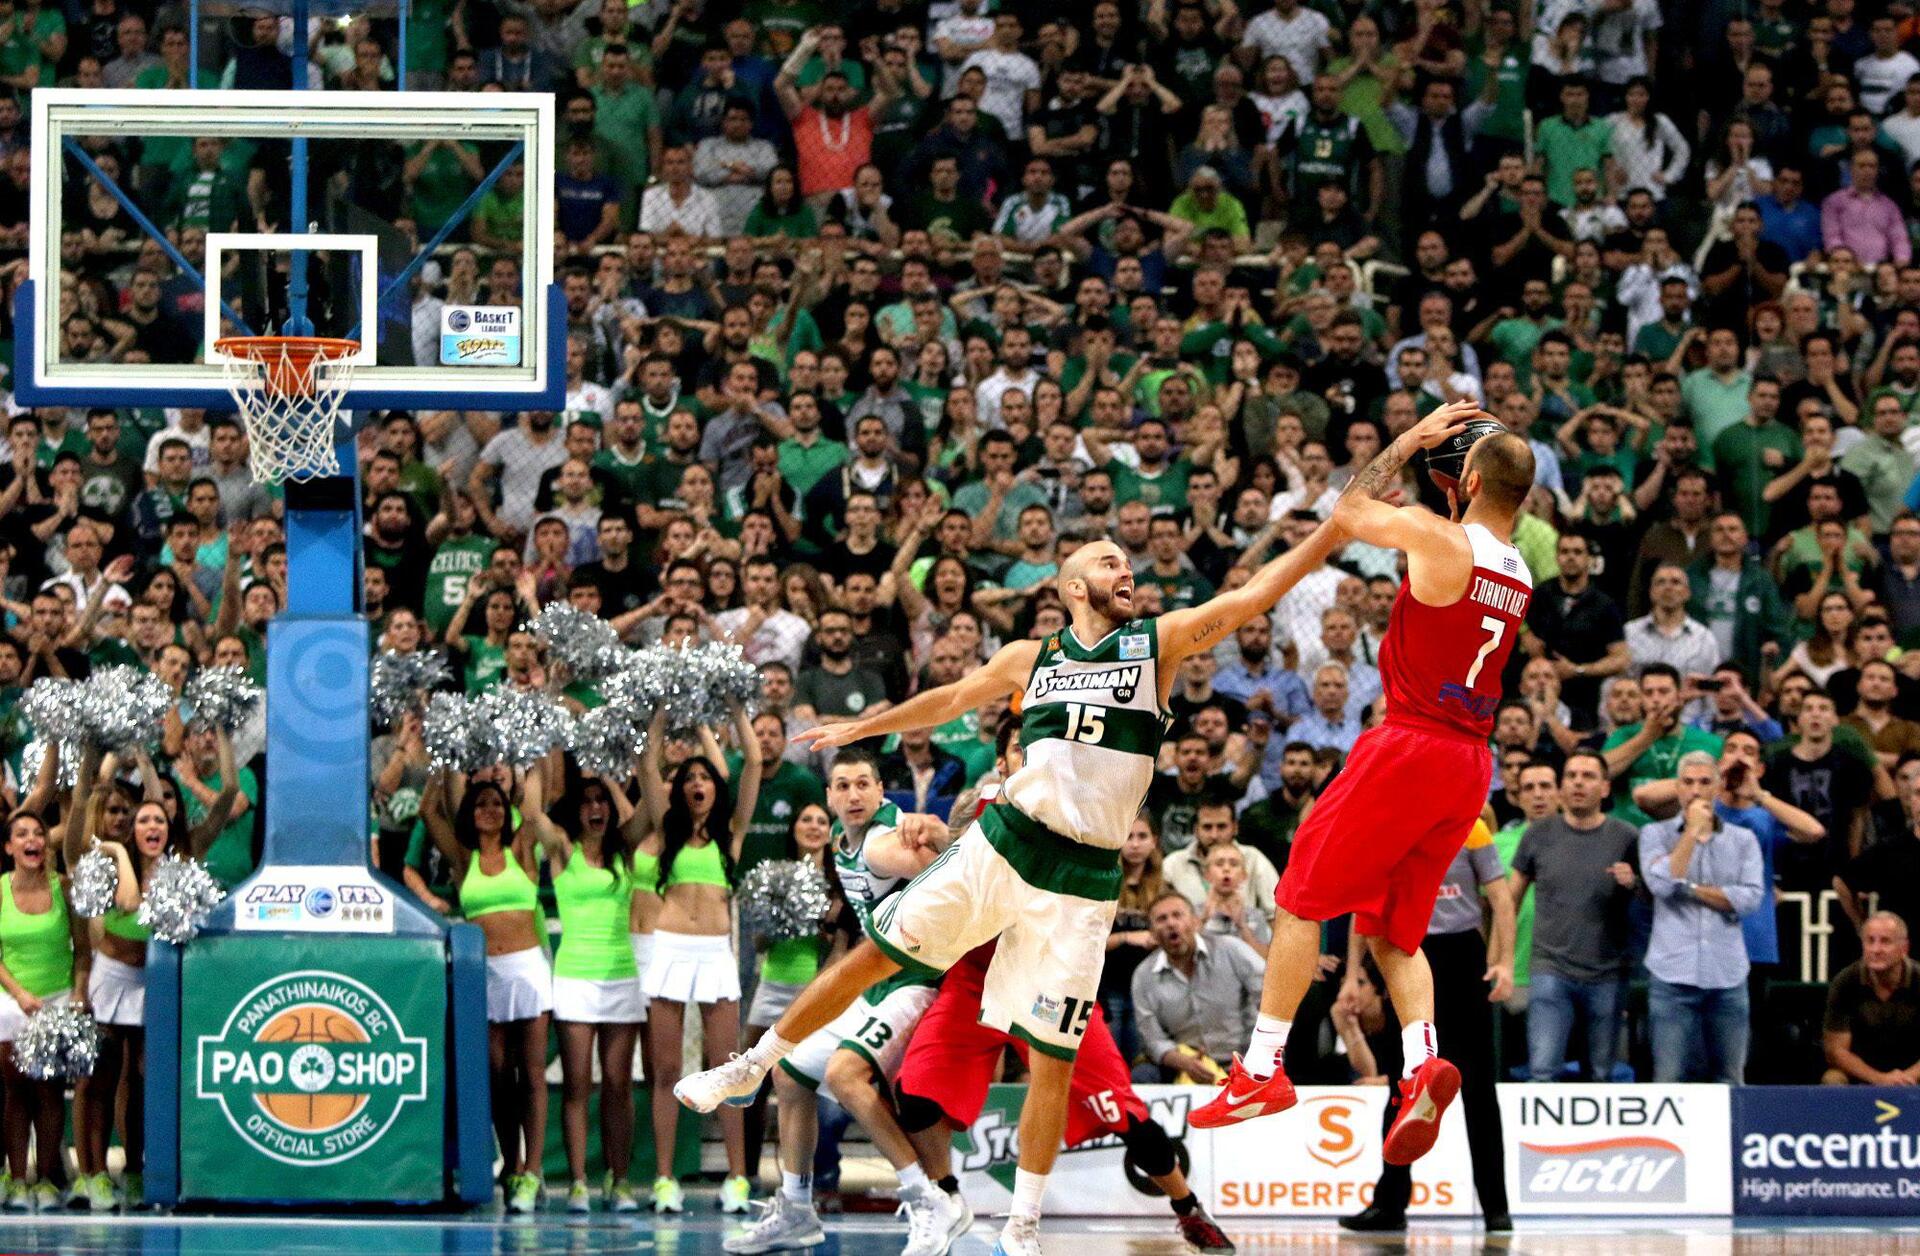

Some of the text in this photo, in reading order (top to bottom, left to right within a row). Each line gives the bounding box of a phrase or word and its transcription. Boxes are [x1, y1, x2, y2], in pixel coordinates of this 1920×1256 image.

[474, 311, 513, 324] BASKET
[1465, 615, 1506, 689] 7
[1036, 665, 1141, 698] STOIXIMAN
[1116, 687, 1132, 699] GR
[1064, 702, 1107, 745] 15
[245, 885, 305, 903] PLAY
[238, 981, 388, 1036] PANATHINAIKOS BC
[1059, 996, 1094, 1037] 15
[856, 1016, 893, 1049] 13
[212, 1051, 284, 1084] PAO
[337, 1052, 415, 1085] SHOP
[1087, 1089, 1121, 1124] 15
[1520, 1096, 1684, 1126] INDIBA
[246, 1113, 377, 1156] OFFICIAL STORE
[1528, 1154, 1678, 1193] activ
[1742, 1177, 1781, 1202] High
[1784, 1178, 1895, 1202] performance.
[1221, 1181, 1455, 1207] SUPERFODS
